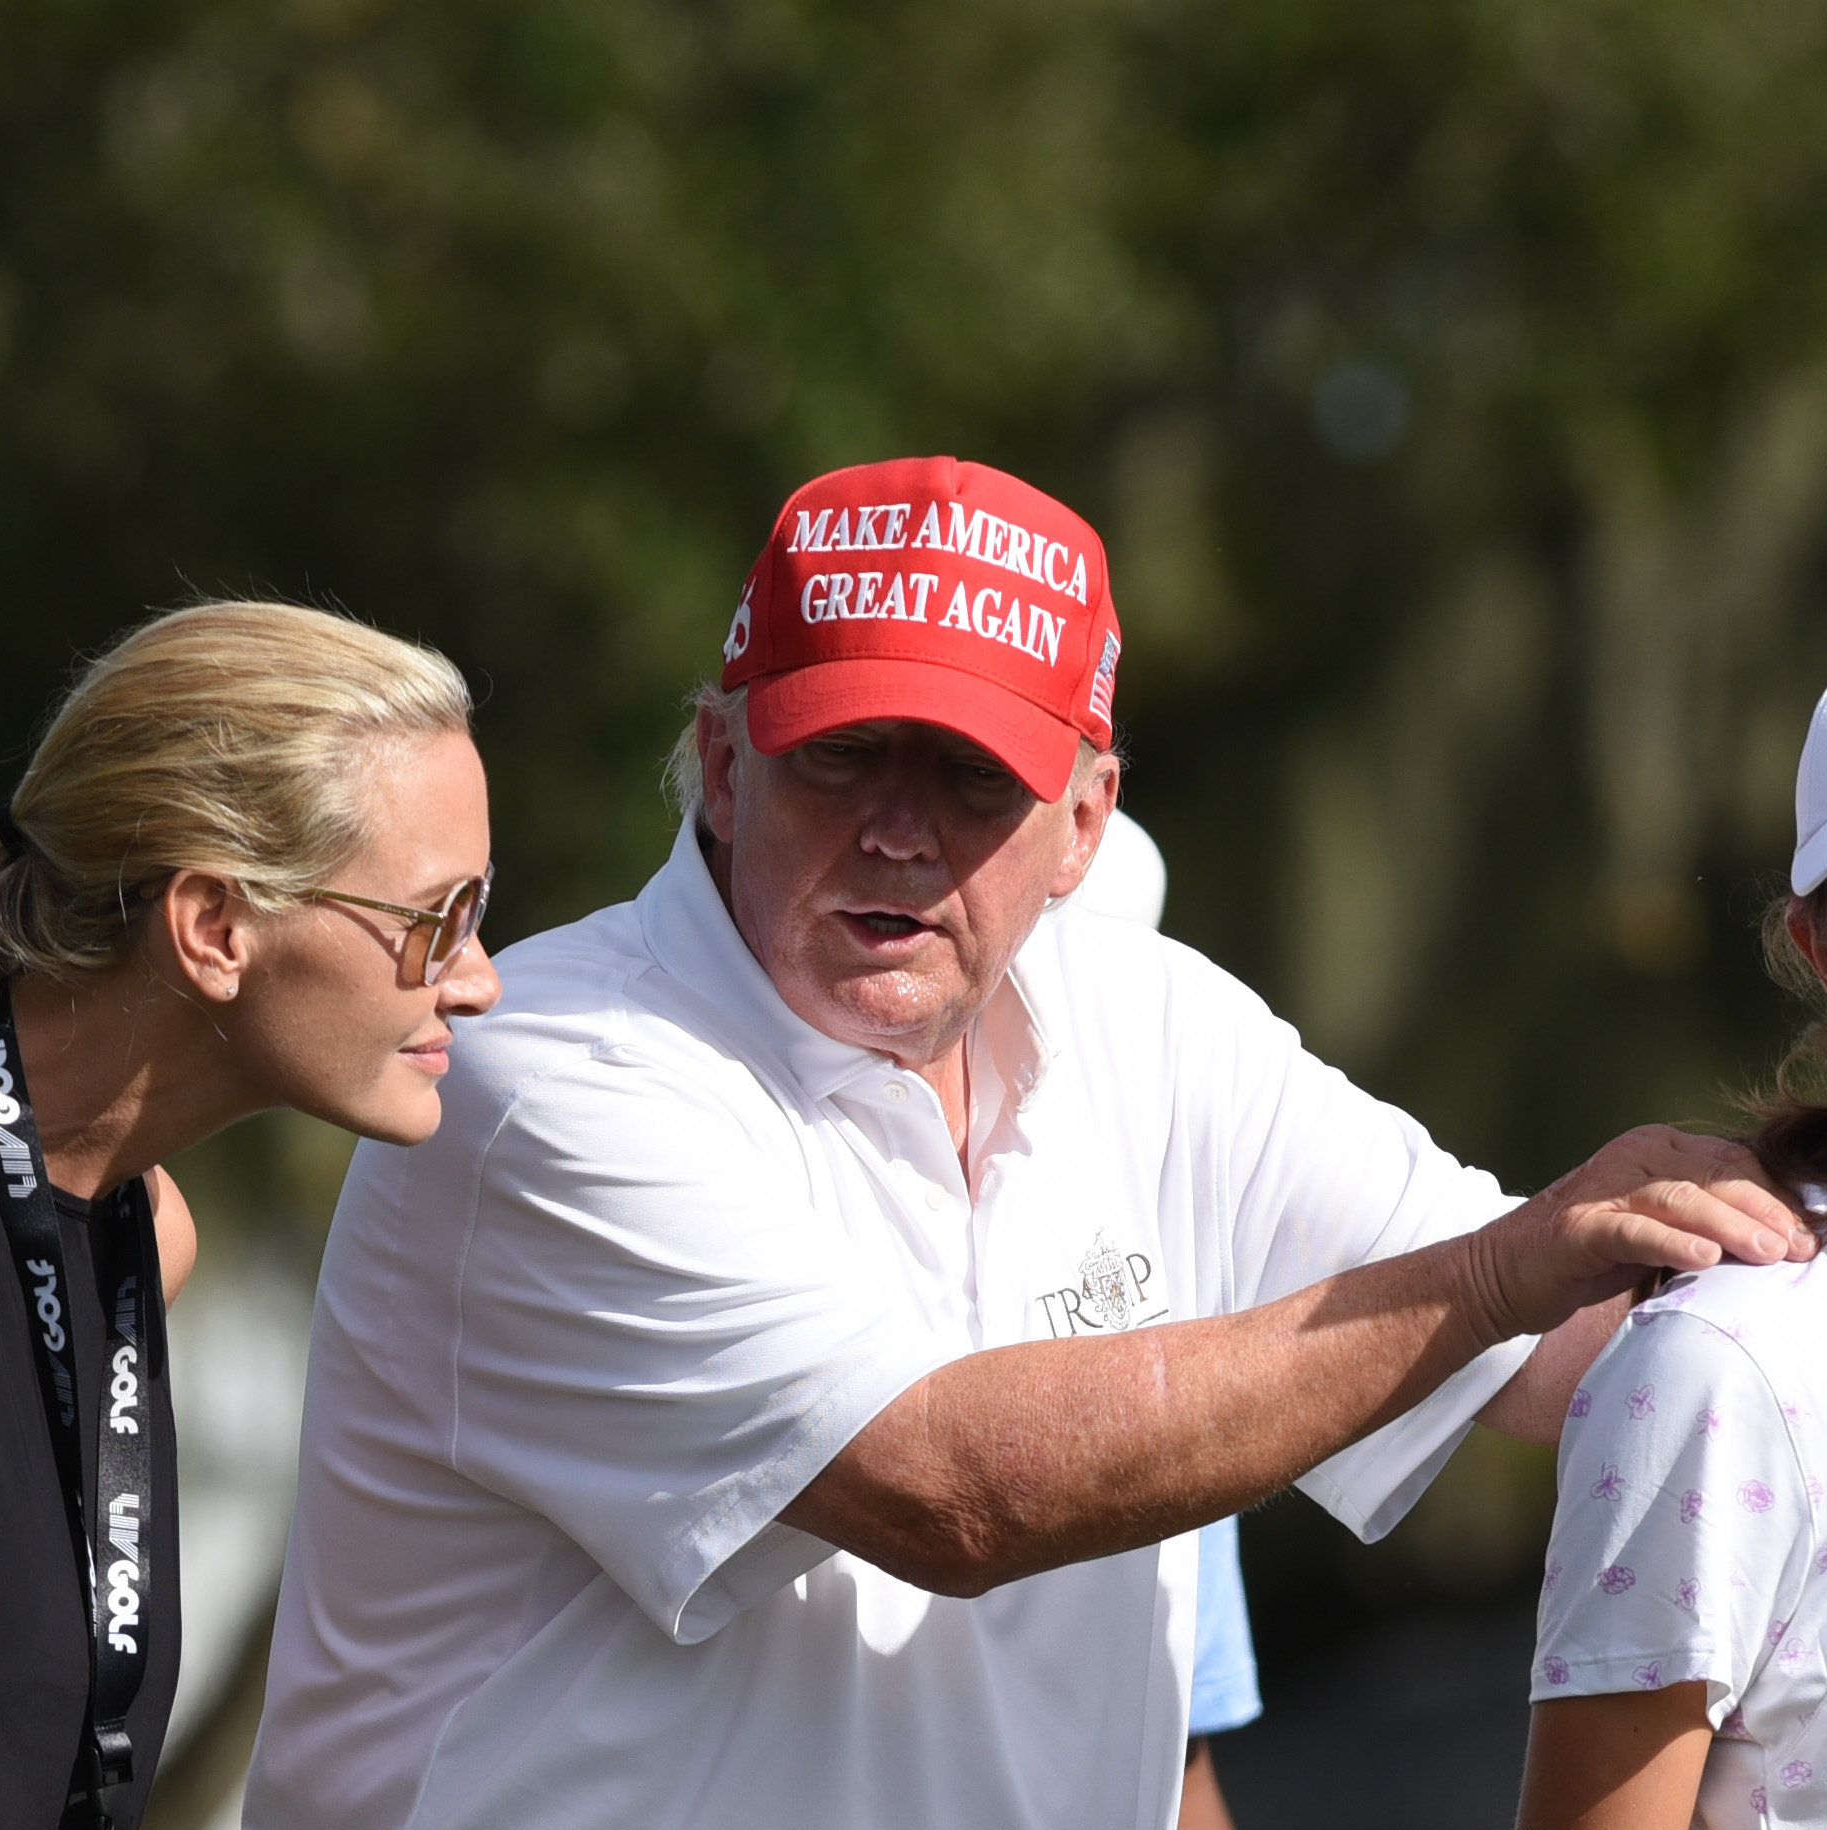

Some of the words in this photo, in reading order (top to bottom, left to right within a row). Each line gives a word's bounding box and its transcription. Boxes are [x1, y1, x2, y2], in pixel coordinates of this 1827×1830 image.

[786, 503, 911, 554] MAKE
[911, 500, 1088, 607] AMERICA
[800, 570, 939, 624] GREAT
[938, 580, 1066, 668] AGAIN
[26, 1258, 66, 1352] GOLF
[1035, 1252, 1152, 1339] TRP
[110, 1345, 138, 1434] GOLF
[109, 1493, 140, 1563] LIV
[107, 1559, 140, 1654] GOLF
